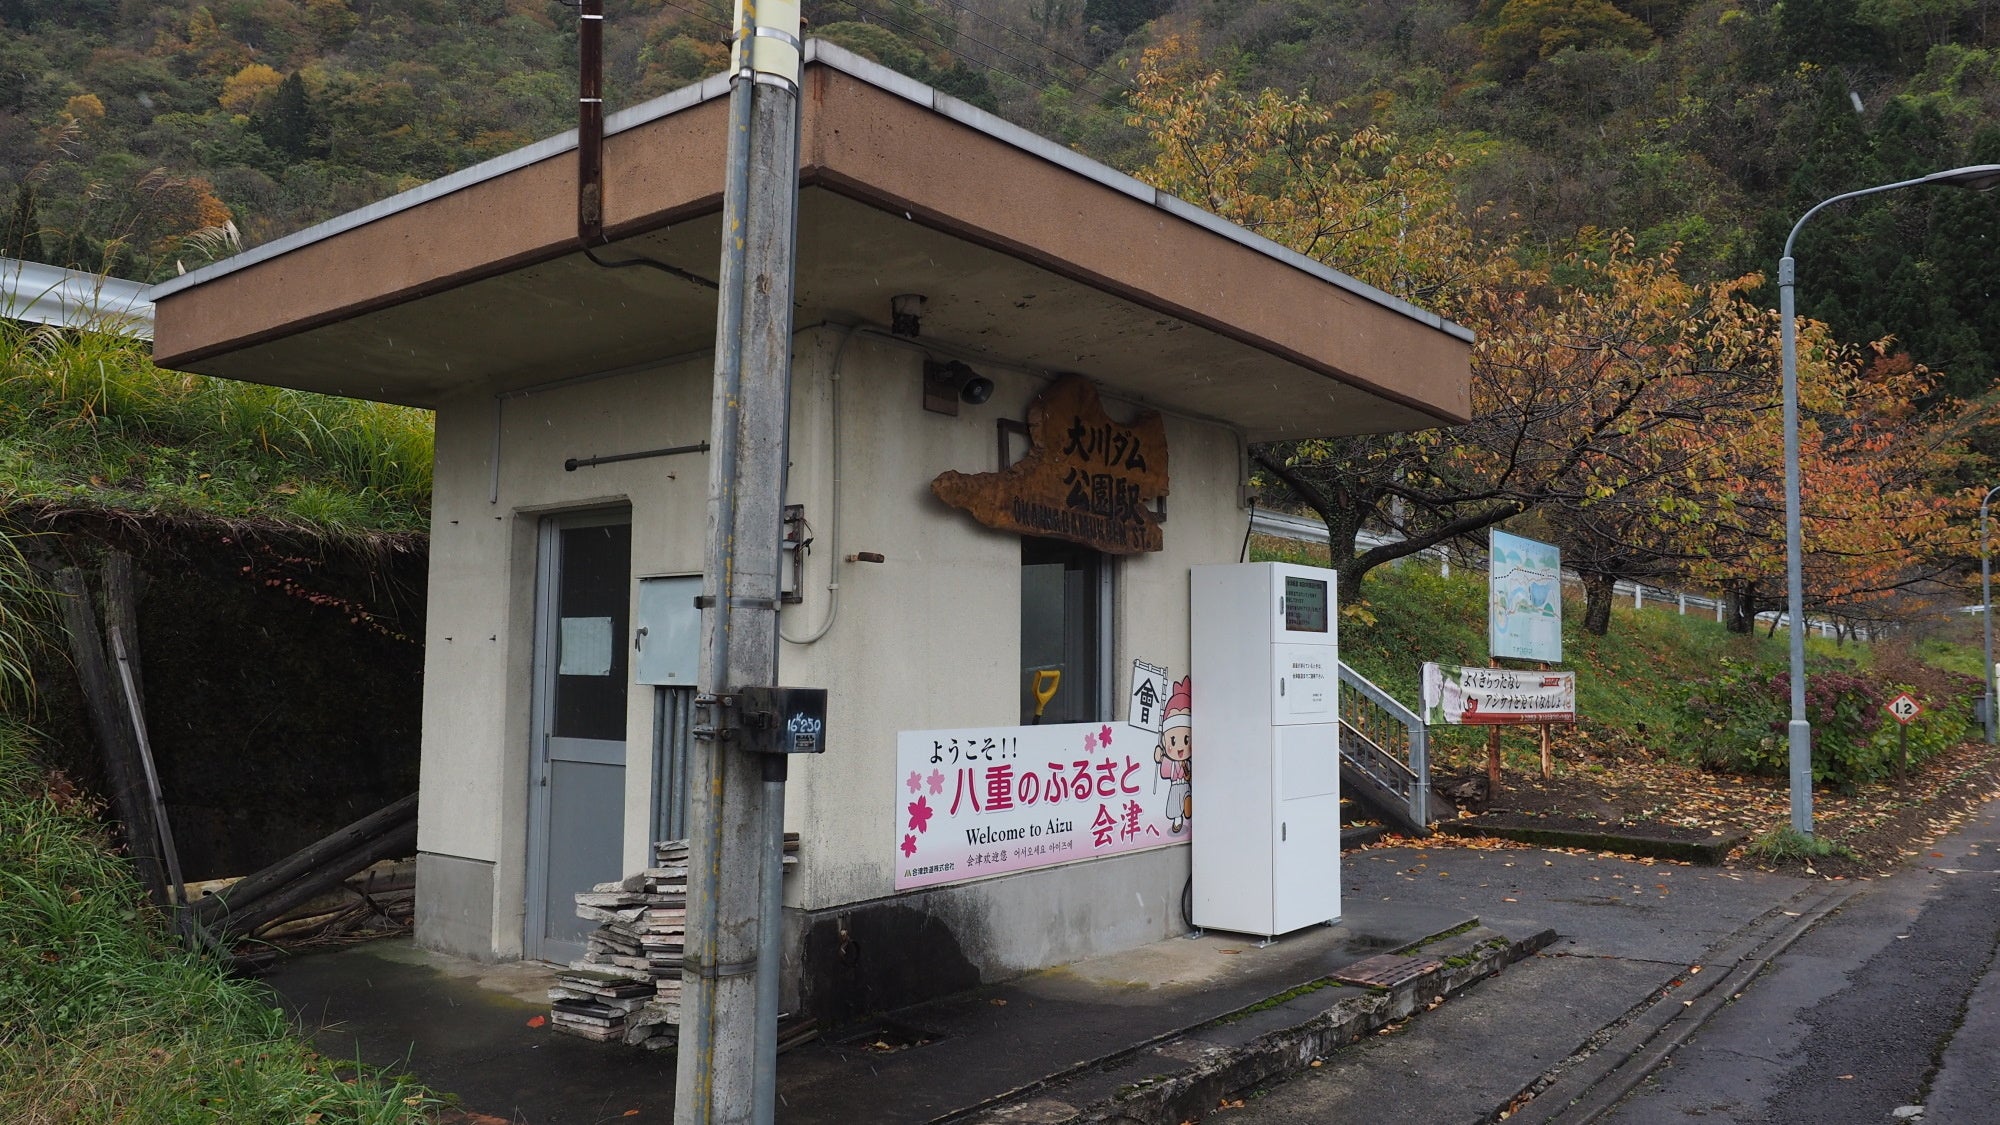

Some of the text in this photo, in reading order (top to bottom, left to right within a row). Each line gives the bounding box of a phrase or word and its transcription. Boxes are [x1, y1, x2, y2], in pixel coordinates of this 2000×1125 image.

[1063, 415, 1147, 474] 大川ダム
[1063, 466, 1145, 526] 公園駅
[1895, 702, 1912, 714] 1.2
[949, 754, 1141, 816] 八重のふるさと
[965, 817, 1073, 847] Welcome to Aizu
[1089, 799, 1161, 848] 会津へ
[966, 850, 1007, 867] 会津欢迎您
[1013, 843, 1047, 860] 어서오세요
